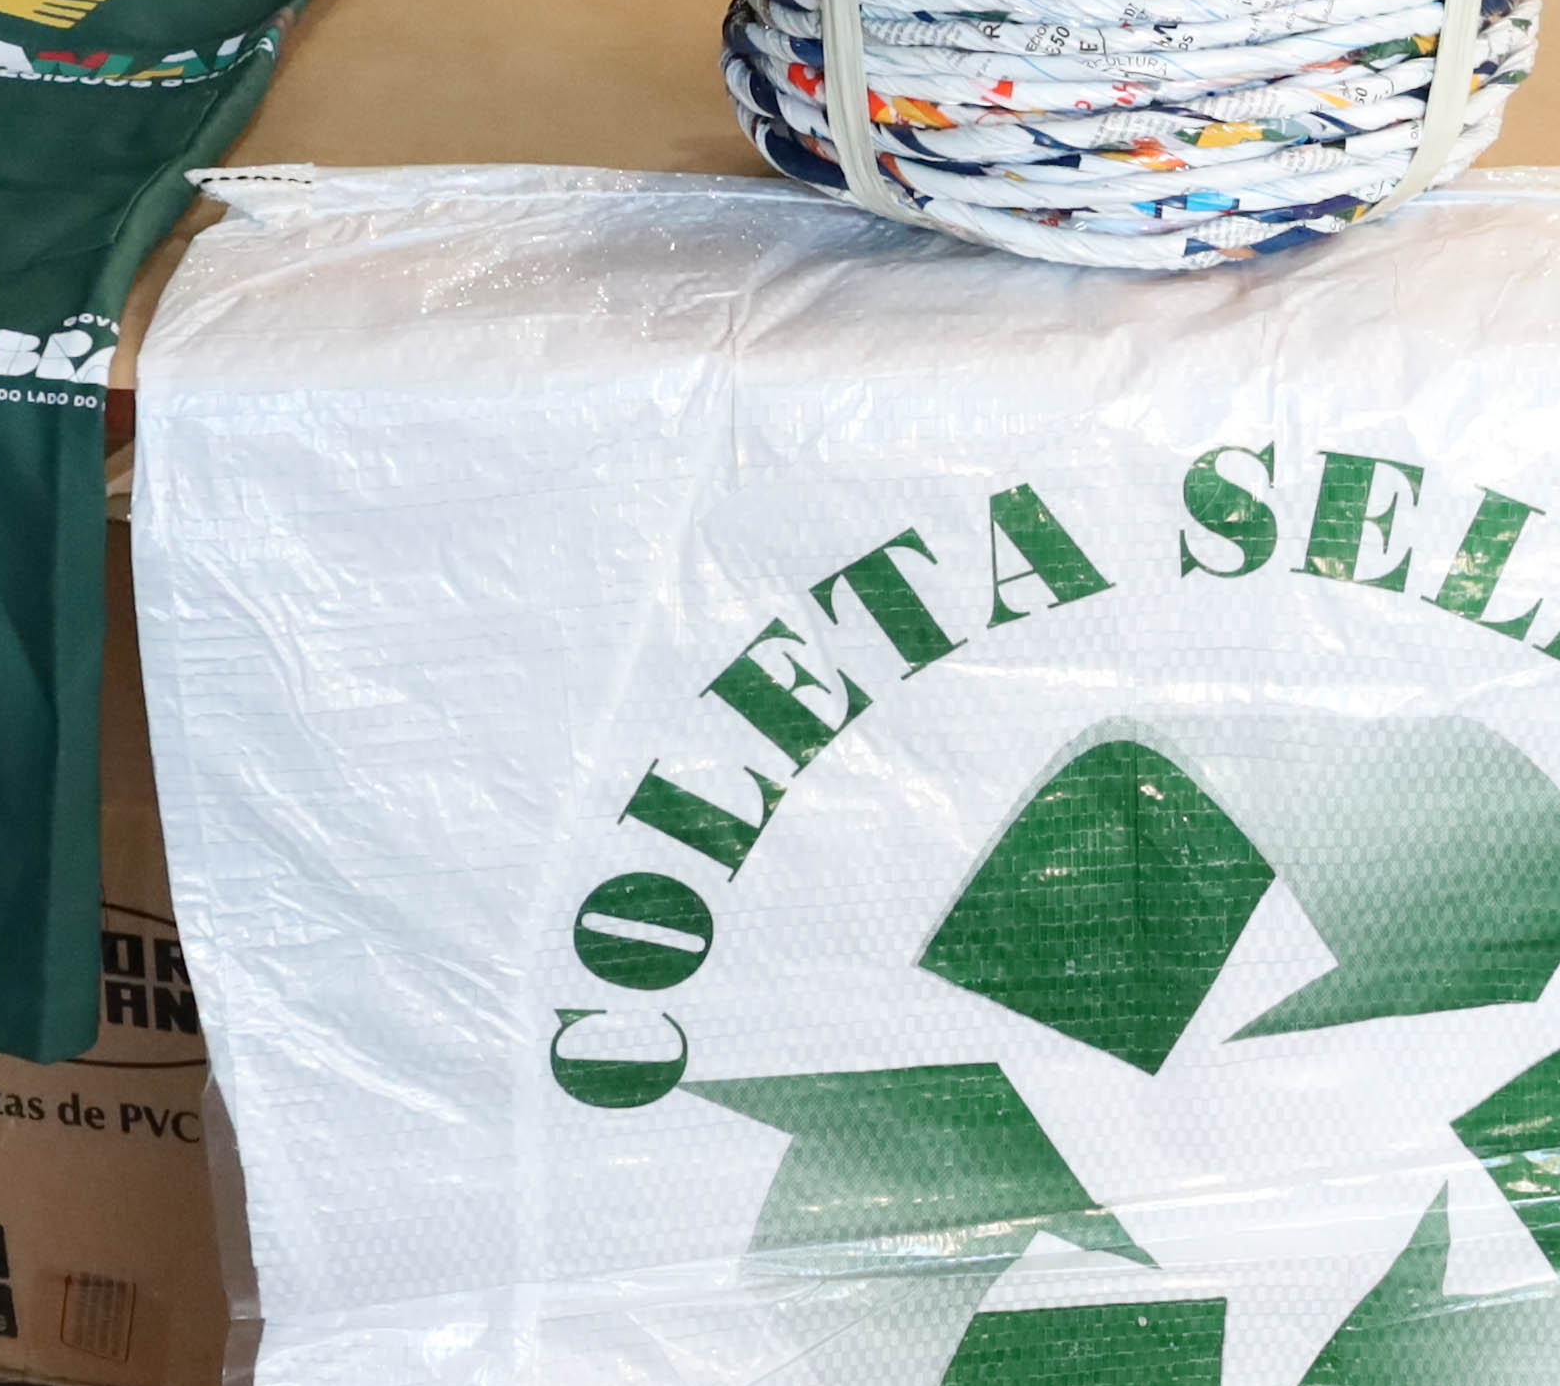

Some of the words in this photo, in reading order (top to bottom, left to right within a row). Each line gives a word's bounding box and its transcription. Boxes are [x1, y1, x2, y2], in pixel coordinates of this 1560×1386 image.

[27, 390, 69, 405] LADO
[74, 394, 97, 409] DO
[549, 482, 1117, 1110] COLETA
[57, 1093, 107, 1131] de
[118, 1102, 201, 1145] PVC
